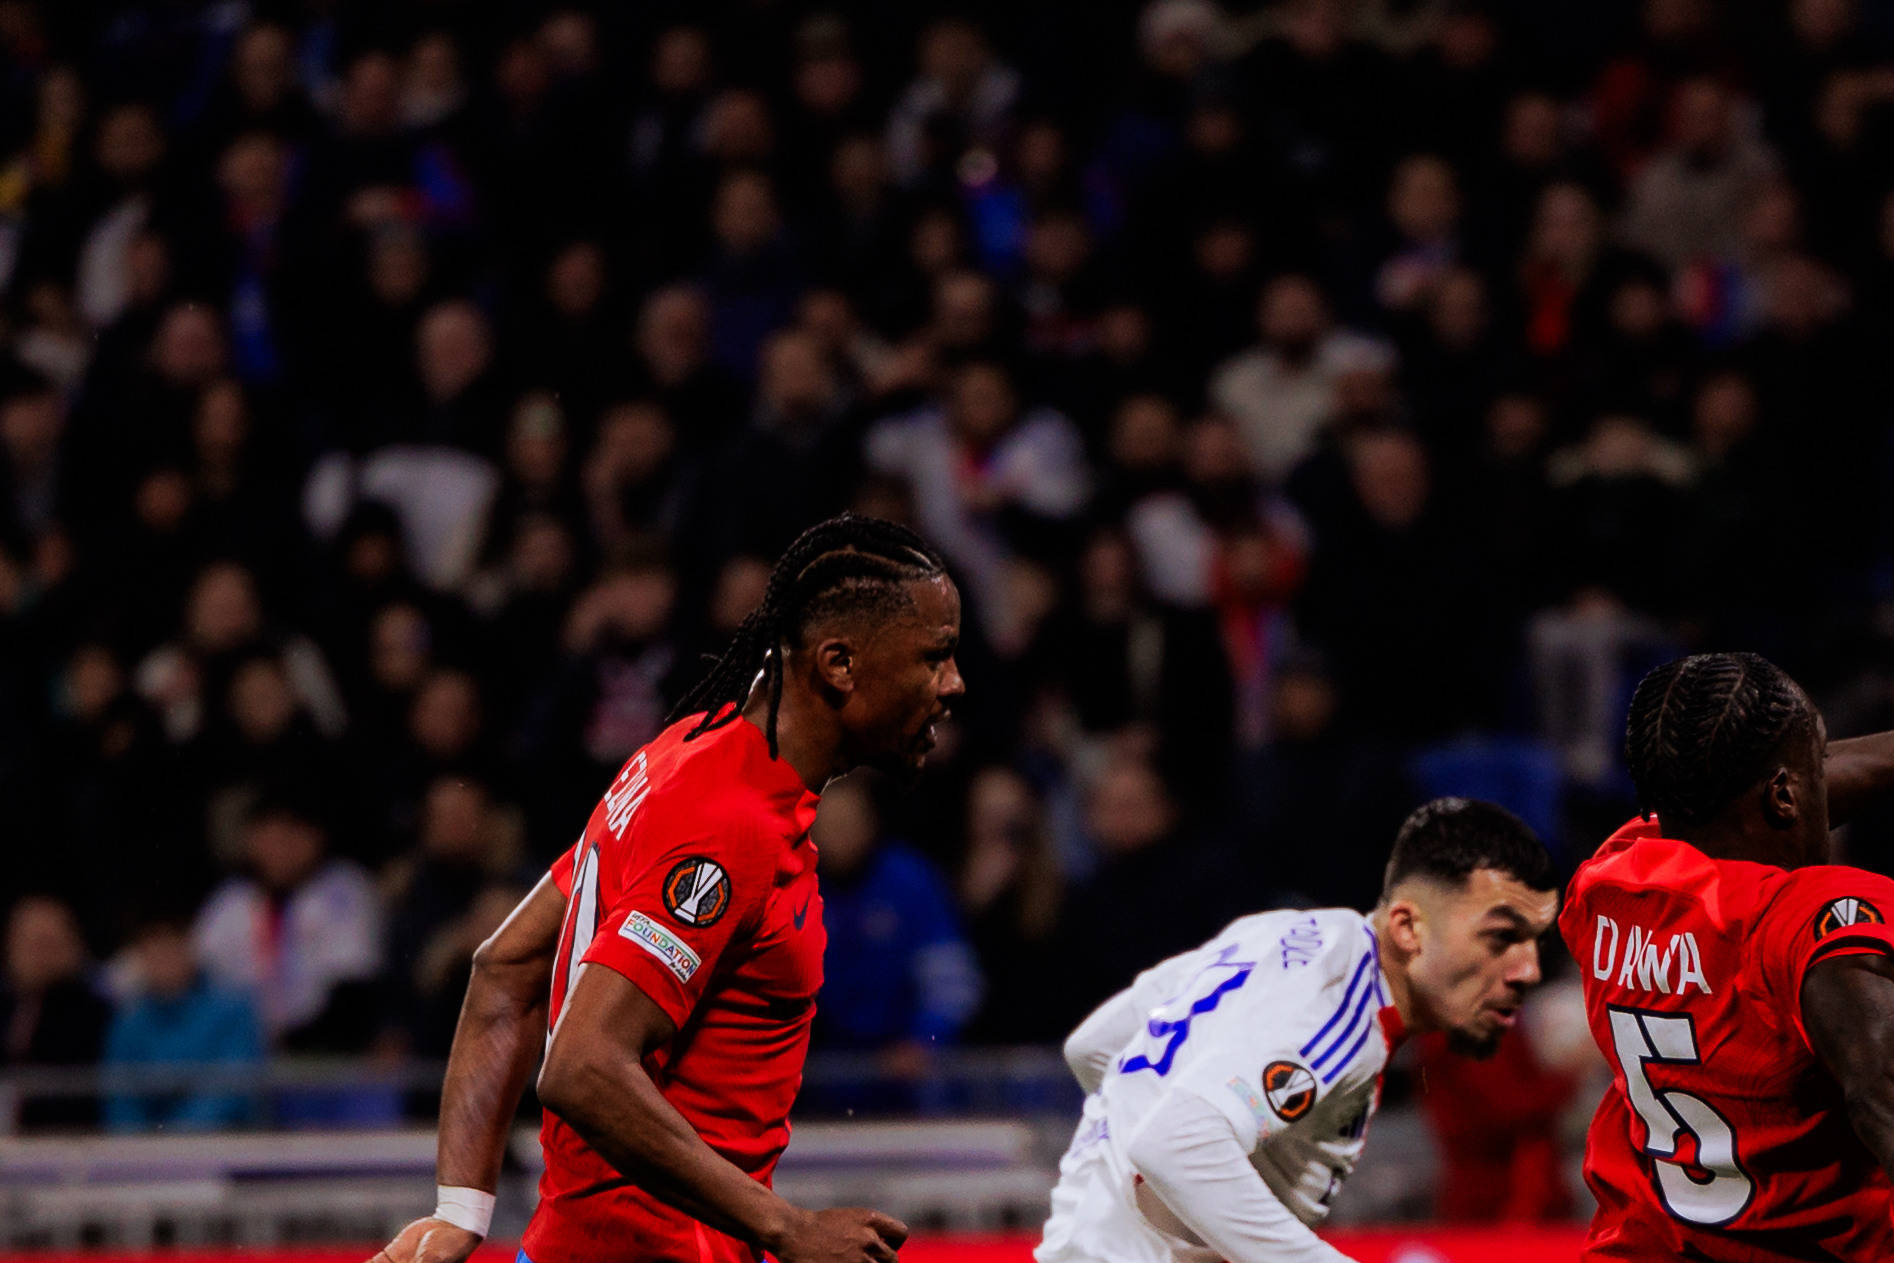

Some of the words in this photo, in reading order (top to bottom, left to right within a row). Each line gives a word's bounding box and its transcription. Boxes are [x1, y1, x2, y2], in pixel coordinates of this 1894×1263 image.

[624, 918, 697, 976] FOUNDATION
[1593, 914, 1713, 995] DAWA
[1606, 1002, 1757, 1228] 5
